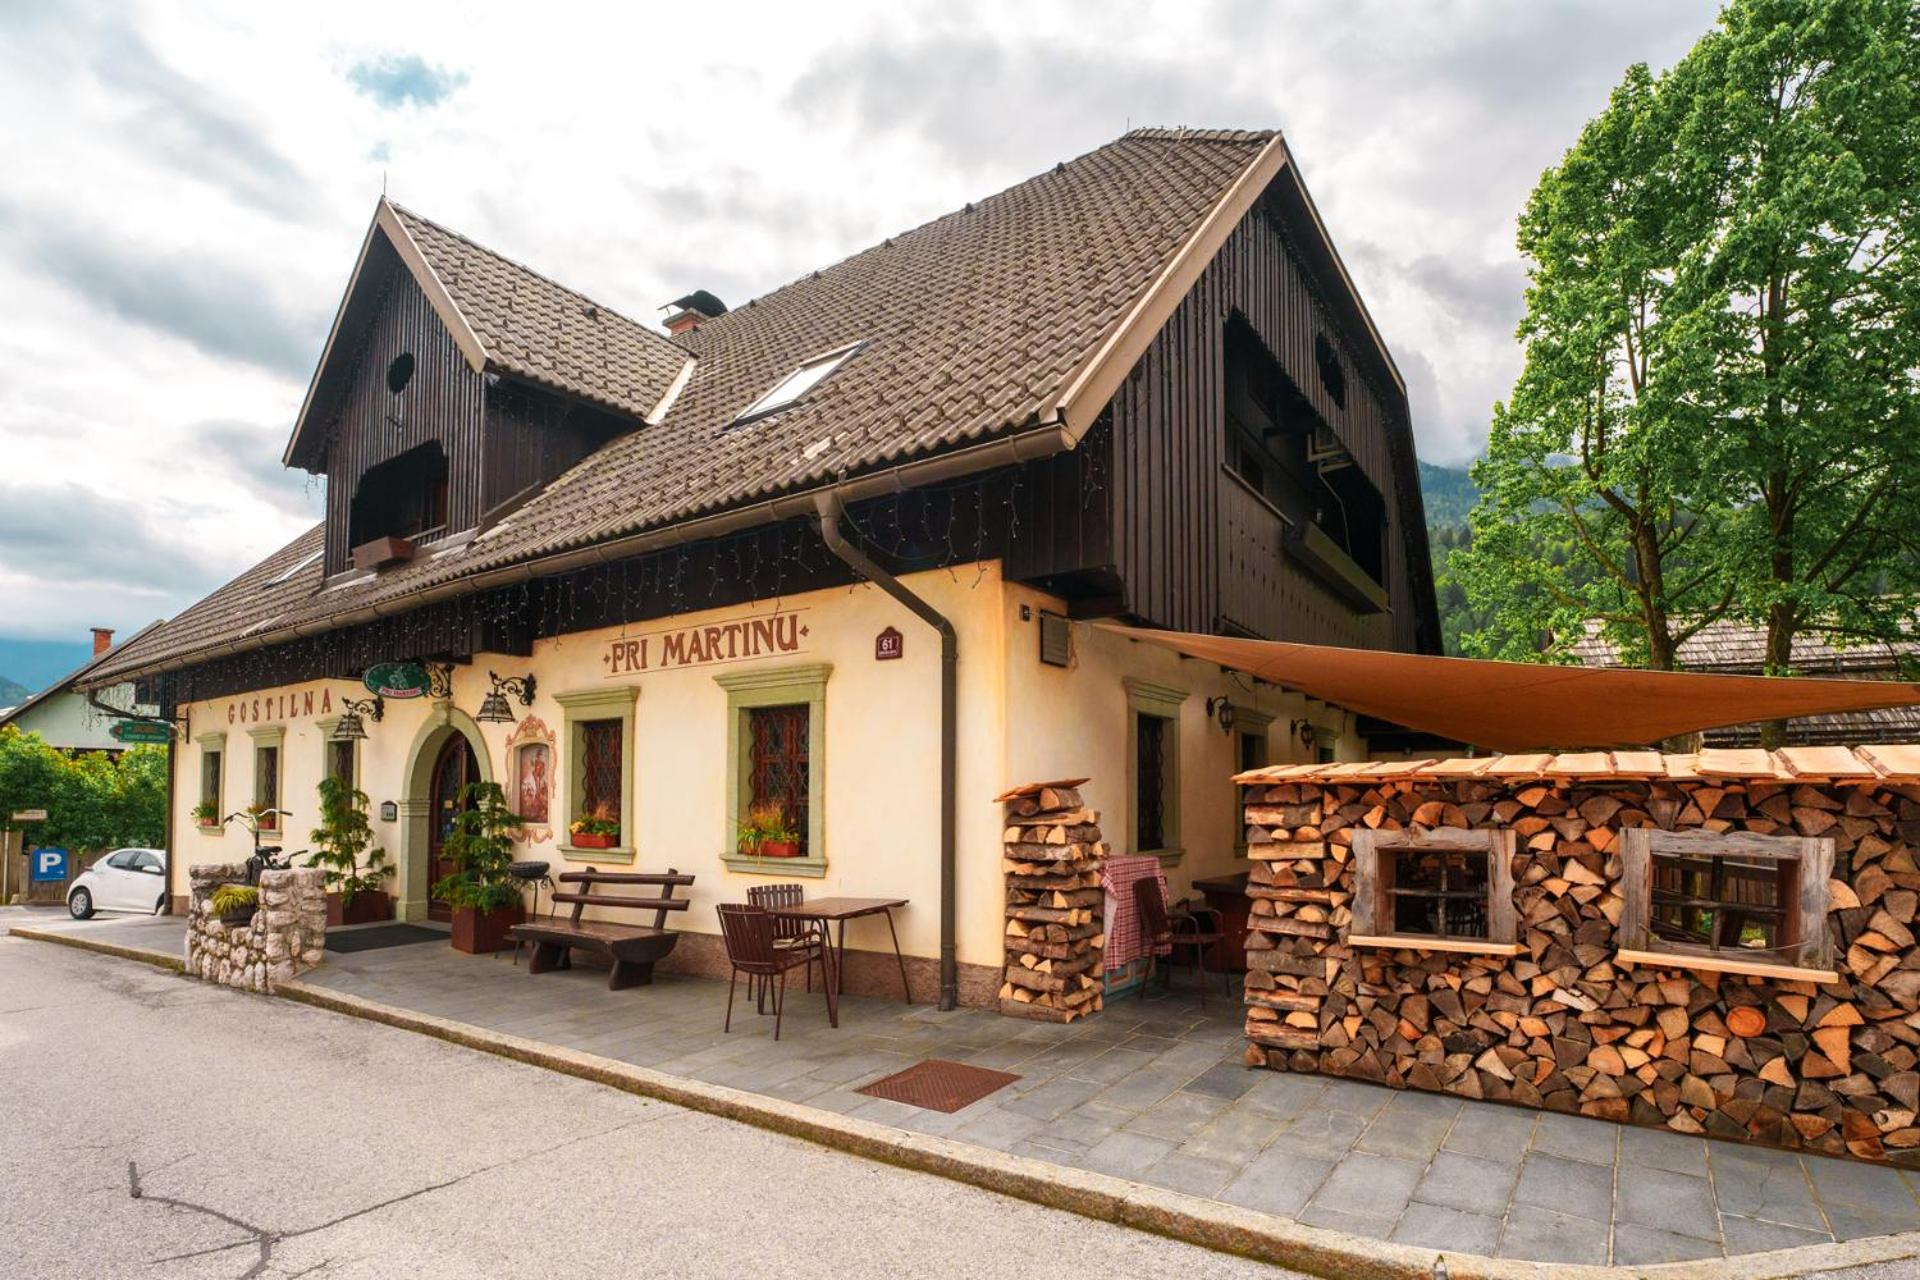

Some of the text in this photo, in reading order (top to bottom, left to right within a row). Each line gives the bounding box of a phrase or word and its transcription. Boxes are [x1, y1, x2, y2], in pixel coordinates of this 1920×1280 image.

[611, 614, 799, 672] PRI MARTINU
[882, 639, 892, 650] 61
[228, 687, 332, 725] GOSTILNA
[40, 853, 62, 873] P
